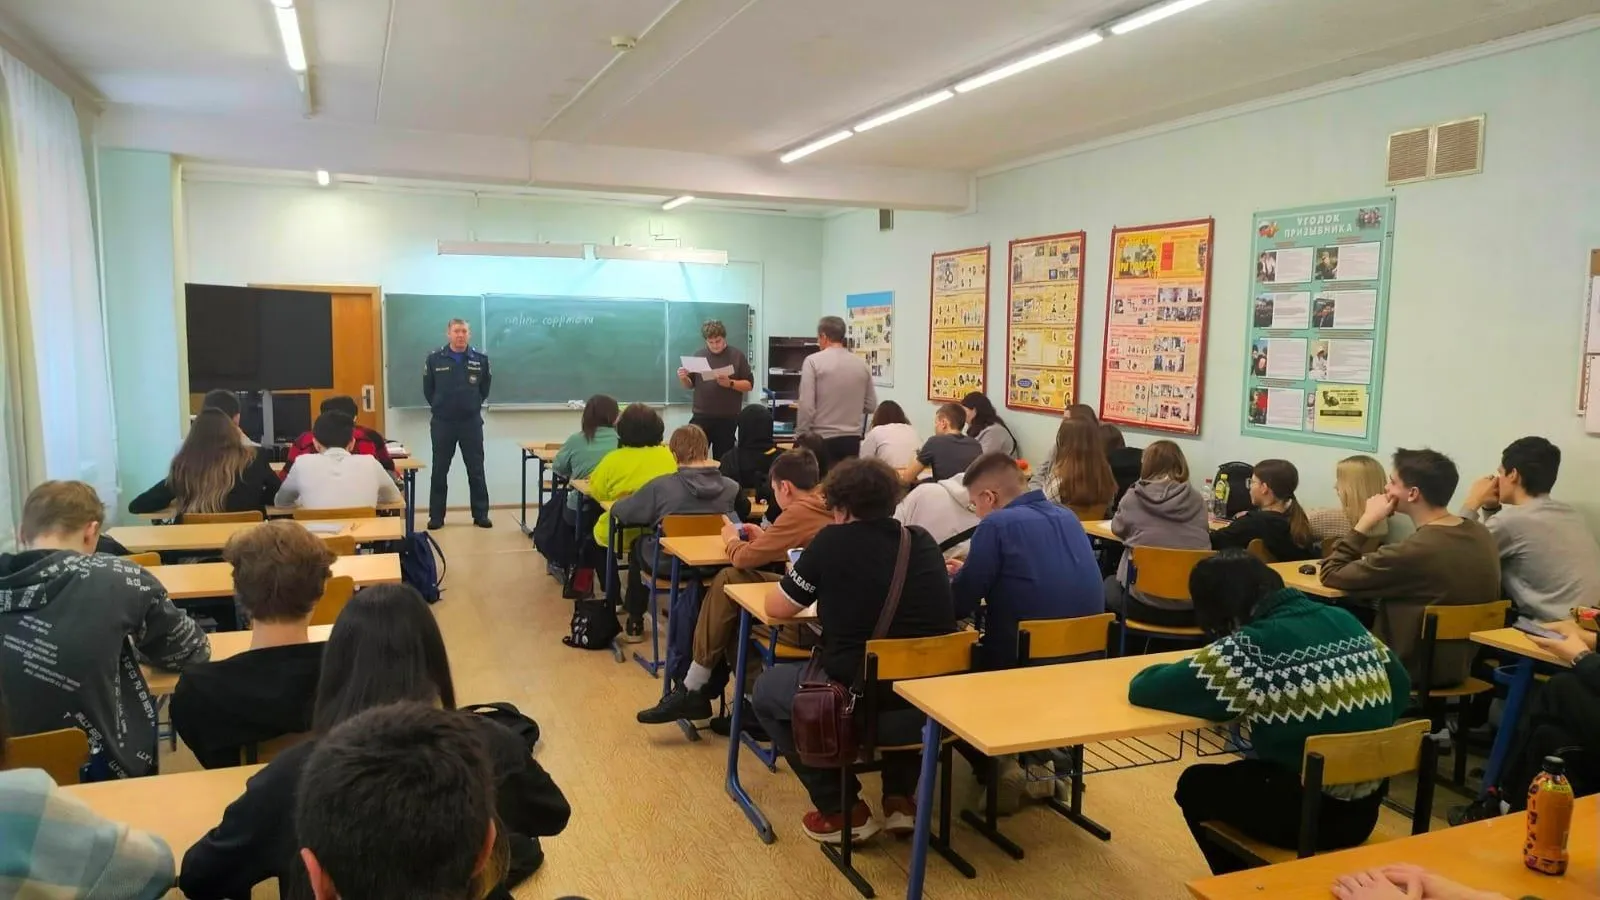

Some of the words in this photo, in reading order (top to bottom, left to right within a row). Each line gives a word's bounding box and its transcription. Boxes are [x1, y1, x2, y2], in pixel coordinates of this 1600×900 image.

[1297, 214, 1340, 226] УГОЛОК
[1285, 223, 1353, 238] ПРИЗЫВНИКА
[790, 569, 816, 593] PLEASE
